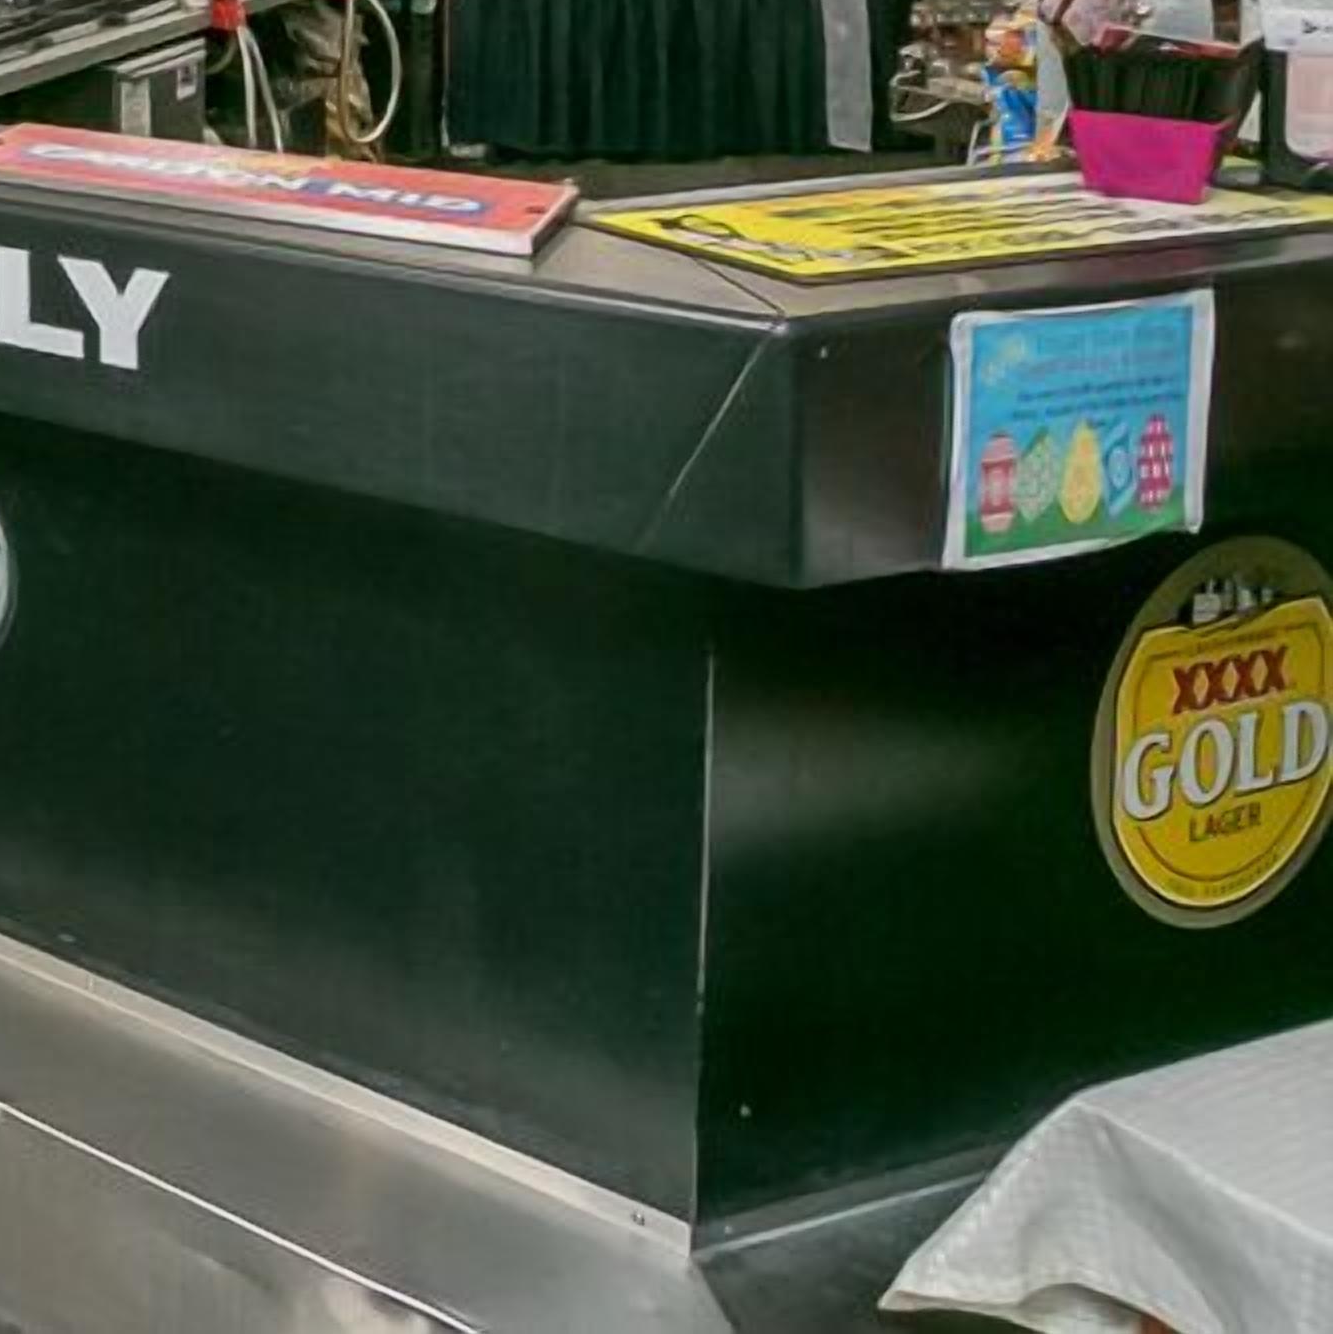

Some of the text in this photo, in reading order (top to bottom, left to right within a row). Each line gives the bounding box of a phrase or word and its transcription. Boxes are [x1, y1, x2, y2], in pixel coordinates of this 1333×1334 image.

[1172, 644, 1290, 715] XXXX
[1122, 701, 1330, 820] GOLD
[1189, 801, 1261, 844] LAGER
